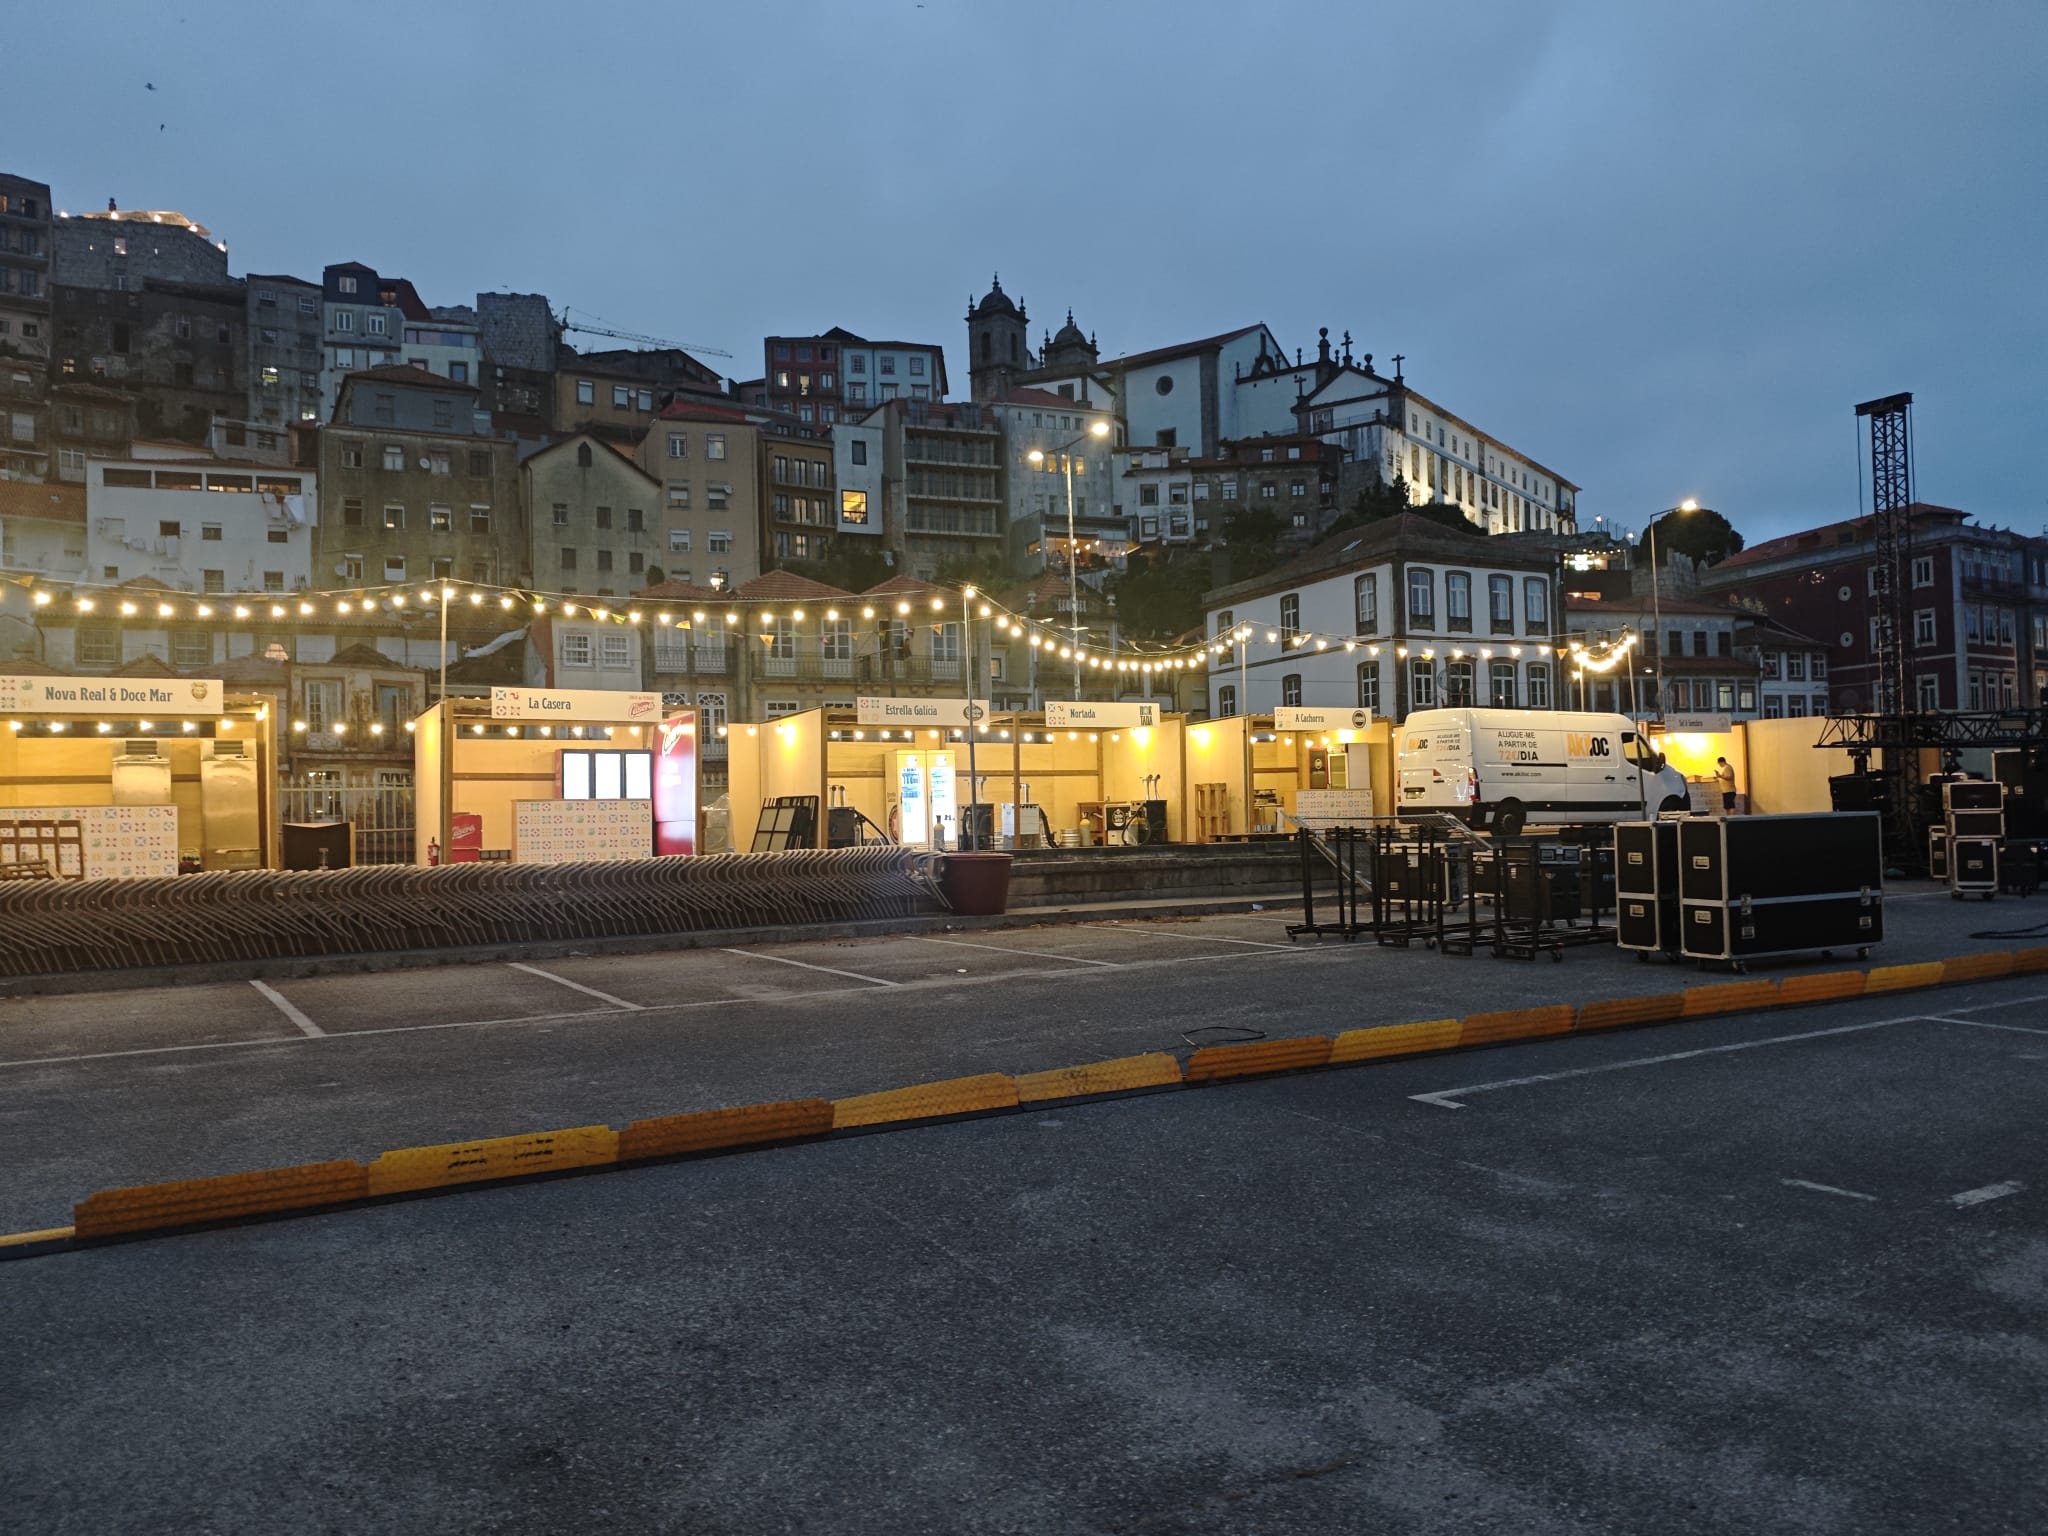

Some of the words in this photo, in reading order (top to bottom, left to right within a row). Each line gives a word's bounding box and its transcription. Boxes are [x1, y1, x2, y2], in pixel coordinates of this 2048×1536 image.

[45, 686, 77, 701] Nova
[80, 687, 107, 702] Real
[110, 687, 117, 702] &
[120, 688, 147, 703] Doce
[150, 688, 174, 703] Mar
[528, 697, 540, 709] La
[542, 698, 572, 710] Casera
[885, 704, 913, 716] Estrella
[1070, 708, 1096, 719] Nortada
[1295, 713, 1300, 723] A
[1497, 730, 1536, 739] ALUGUE-ME
[1498, 740, 1503, 748] A
[1503, 740, 1528, 749] PARTIR
[1528, 741, 1538, 749] DE
